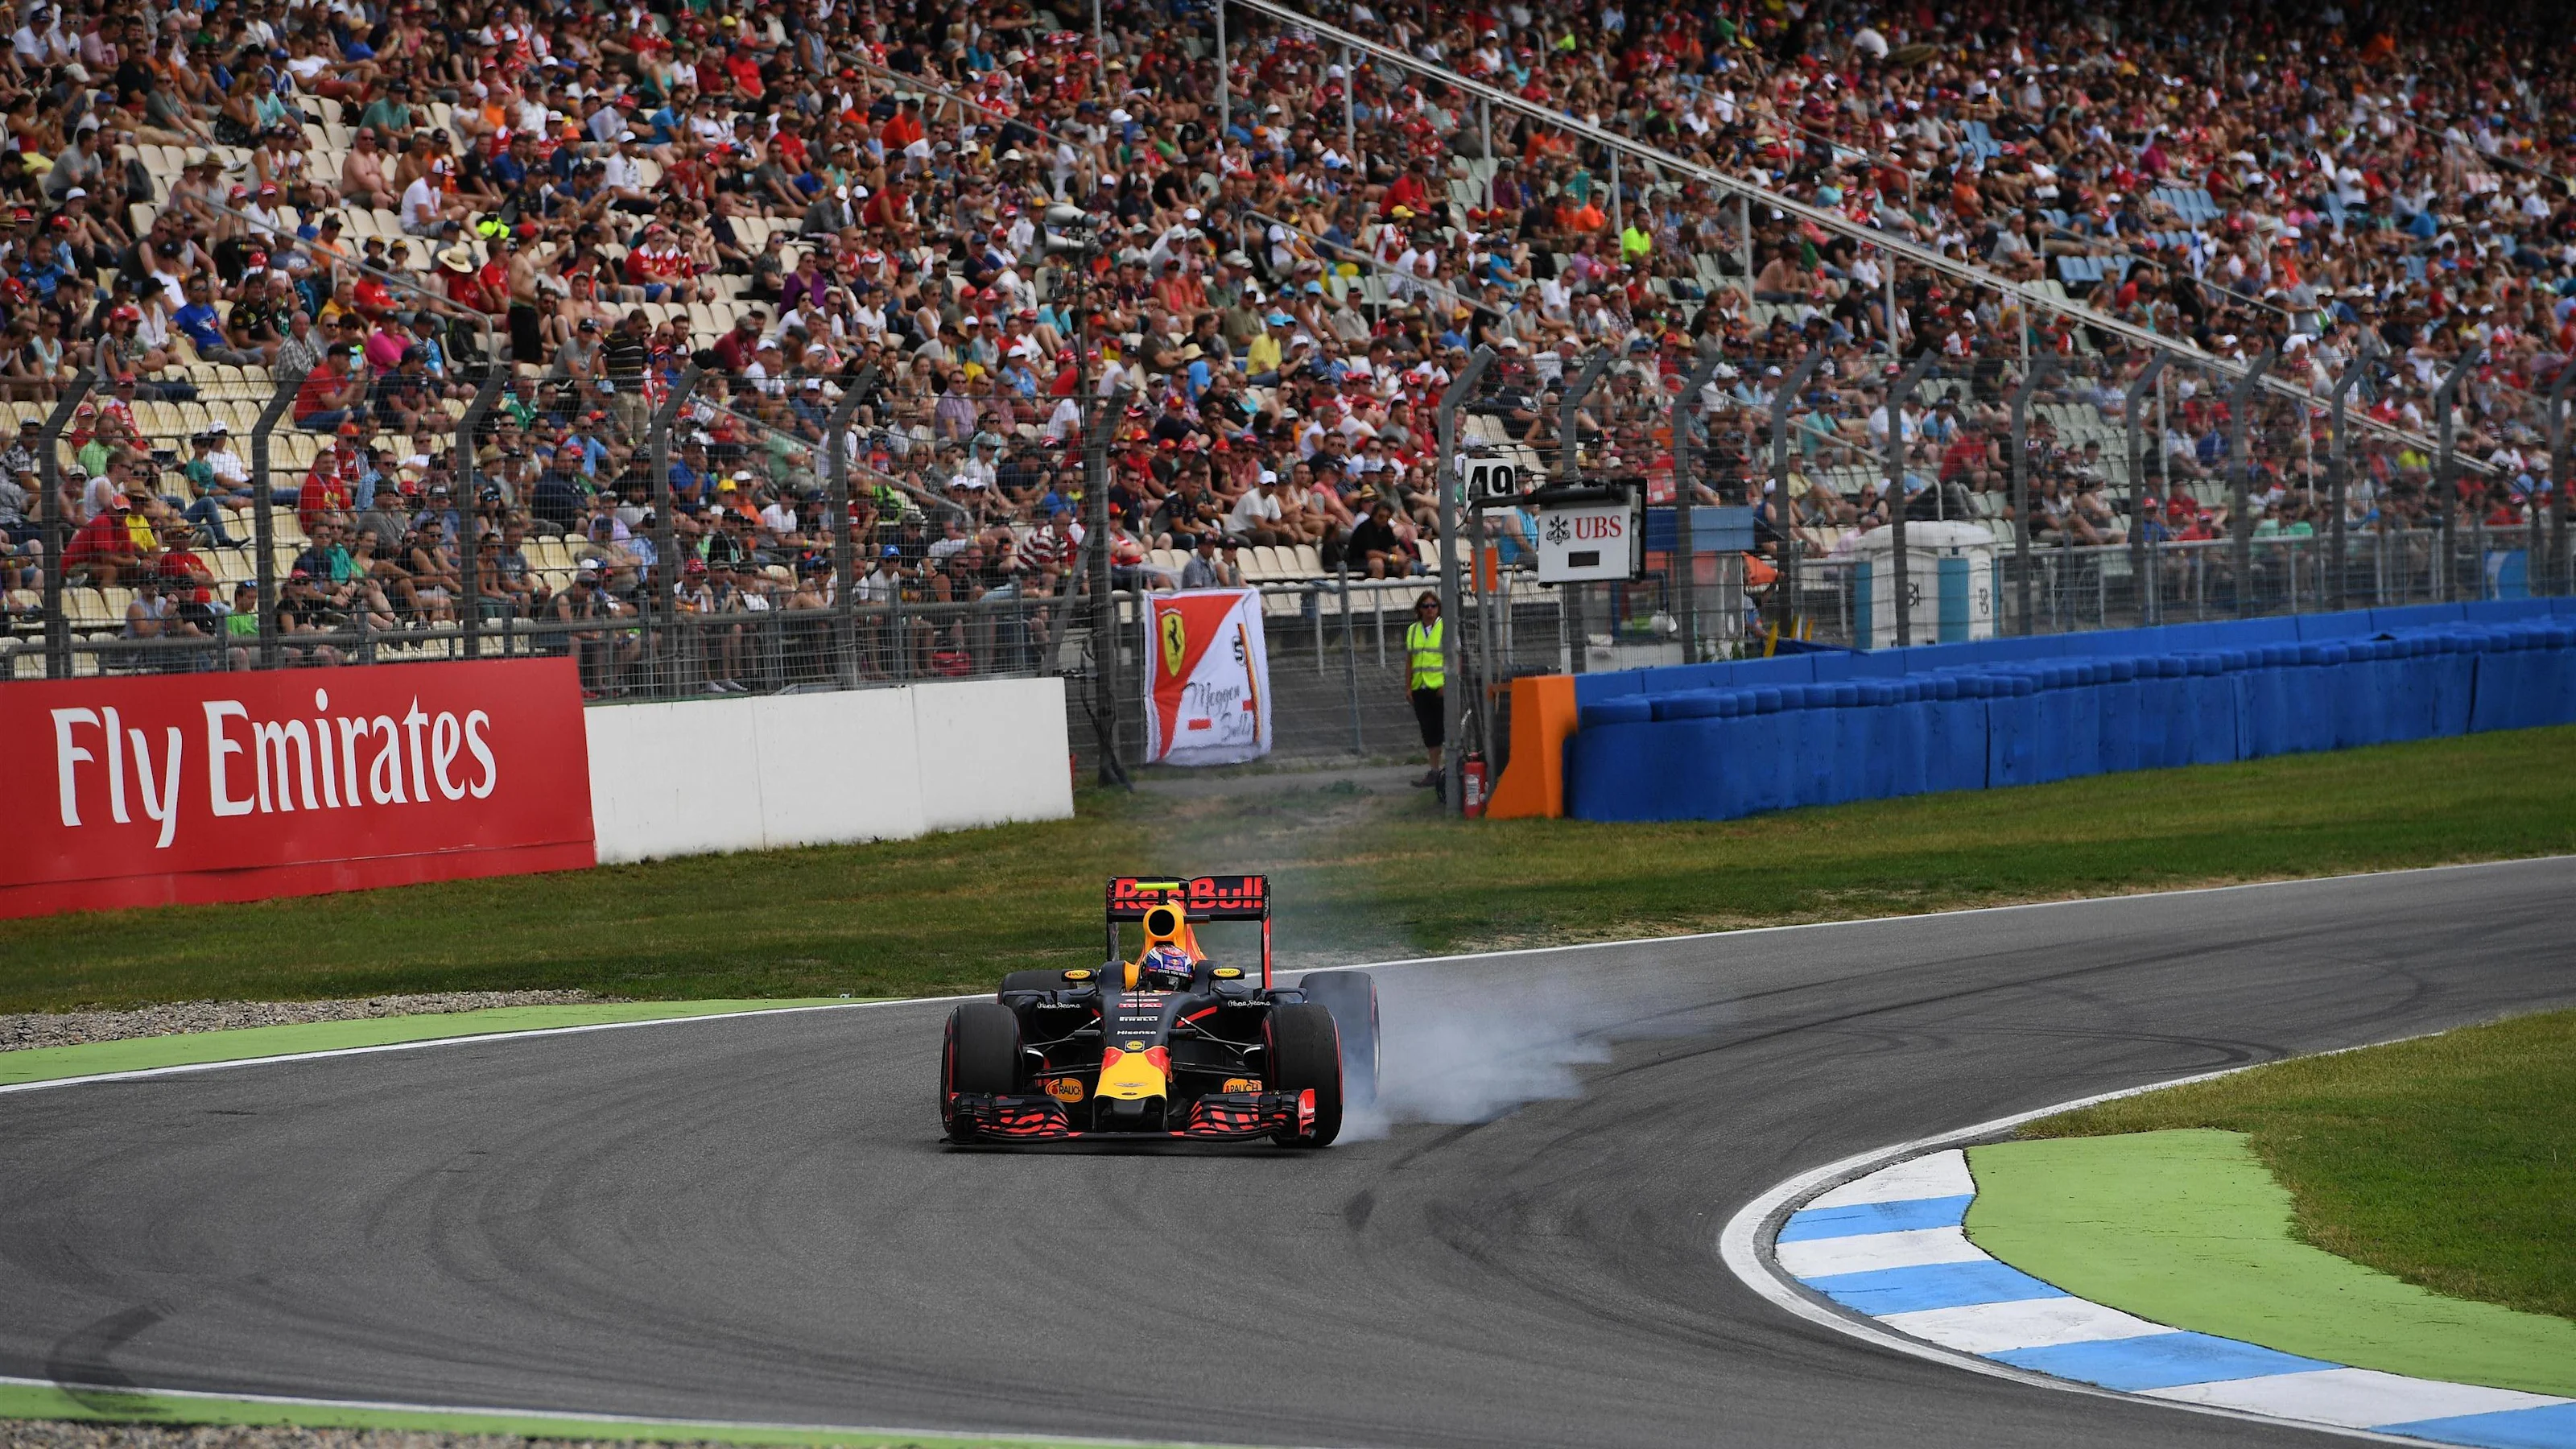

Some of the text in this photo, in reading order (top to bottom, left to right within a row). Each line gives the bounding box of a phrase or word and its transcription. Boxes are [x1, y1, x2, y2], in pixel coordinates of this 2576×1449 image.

[1575, 515, 1622, 539] UBS
[50, 687, 497, 848] Fly Emirates
[1190, 877, 1263, 909] Bull
[1059, 1085, 1081, 1095] RAUCH
